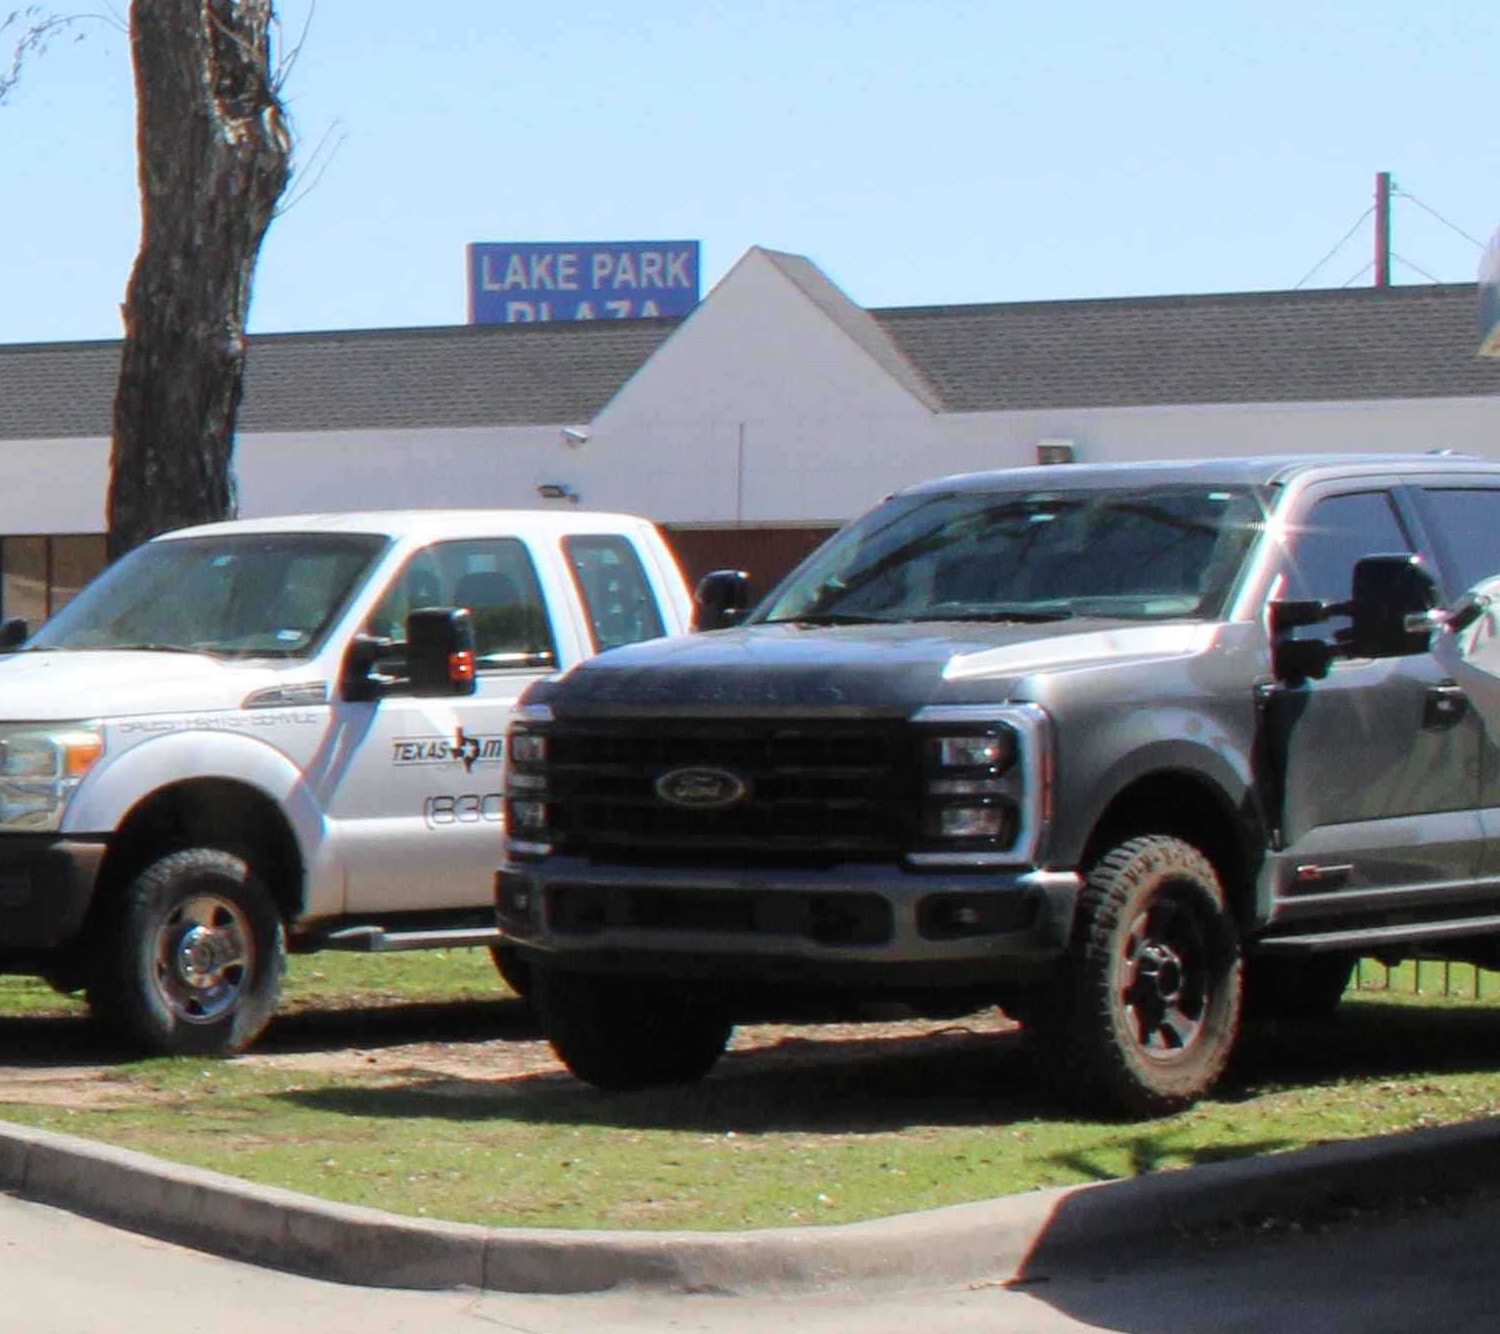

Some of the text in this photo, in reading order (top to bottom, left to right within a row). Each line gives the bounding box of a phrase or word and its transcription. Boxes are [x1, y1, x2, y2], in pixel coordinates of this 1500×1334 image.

[481, 250, 692, 291] LAKE PARK
[392, 741, 448, 763] TEXAS
